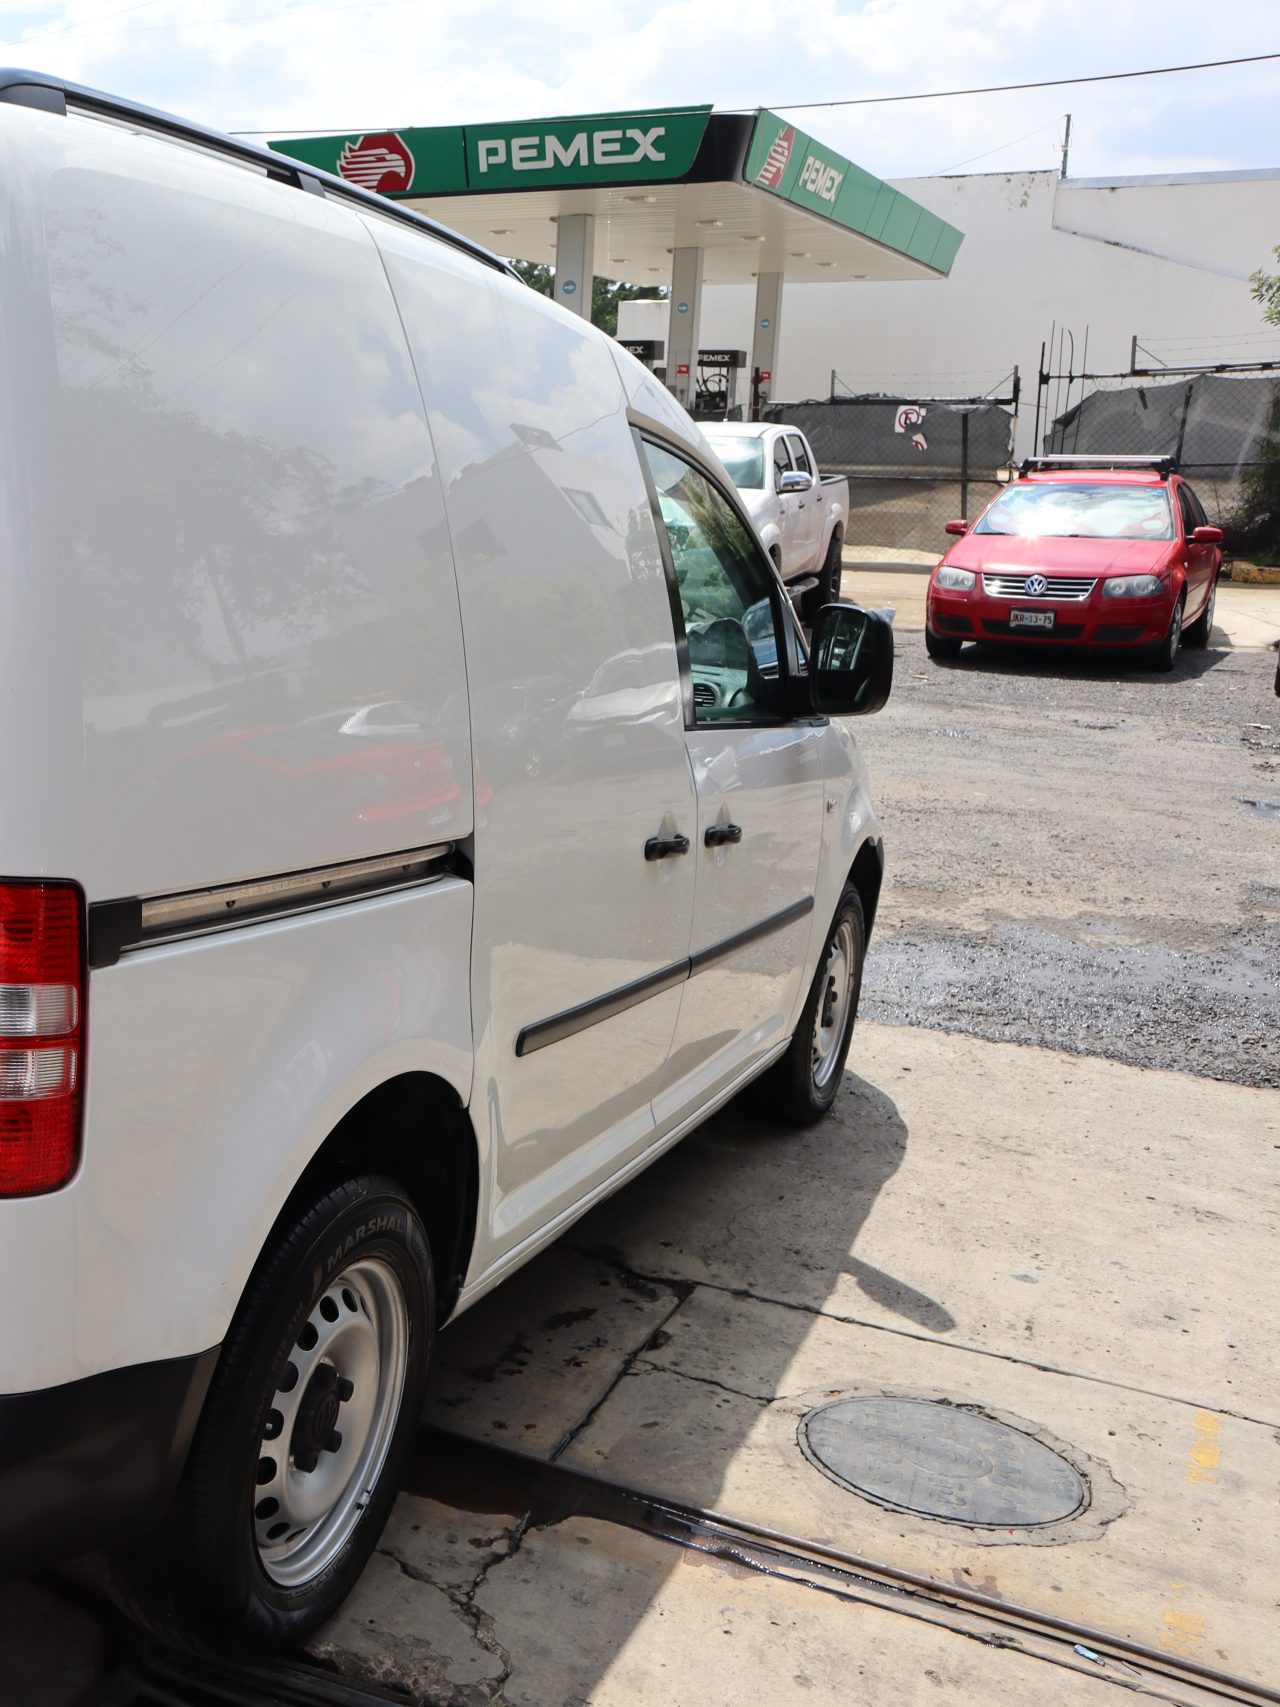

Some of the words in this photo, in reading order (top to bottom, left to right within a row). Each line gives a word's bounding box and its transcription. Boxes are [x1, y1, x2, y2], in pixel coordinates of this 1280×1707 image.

[477, 126, 666, 173] PEMEX
[798, 155, 843, 203] PEMEX
[698, 353, 731, 363] PEMEX
[327, 1215, 404, 1274] MARSHAL
